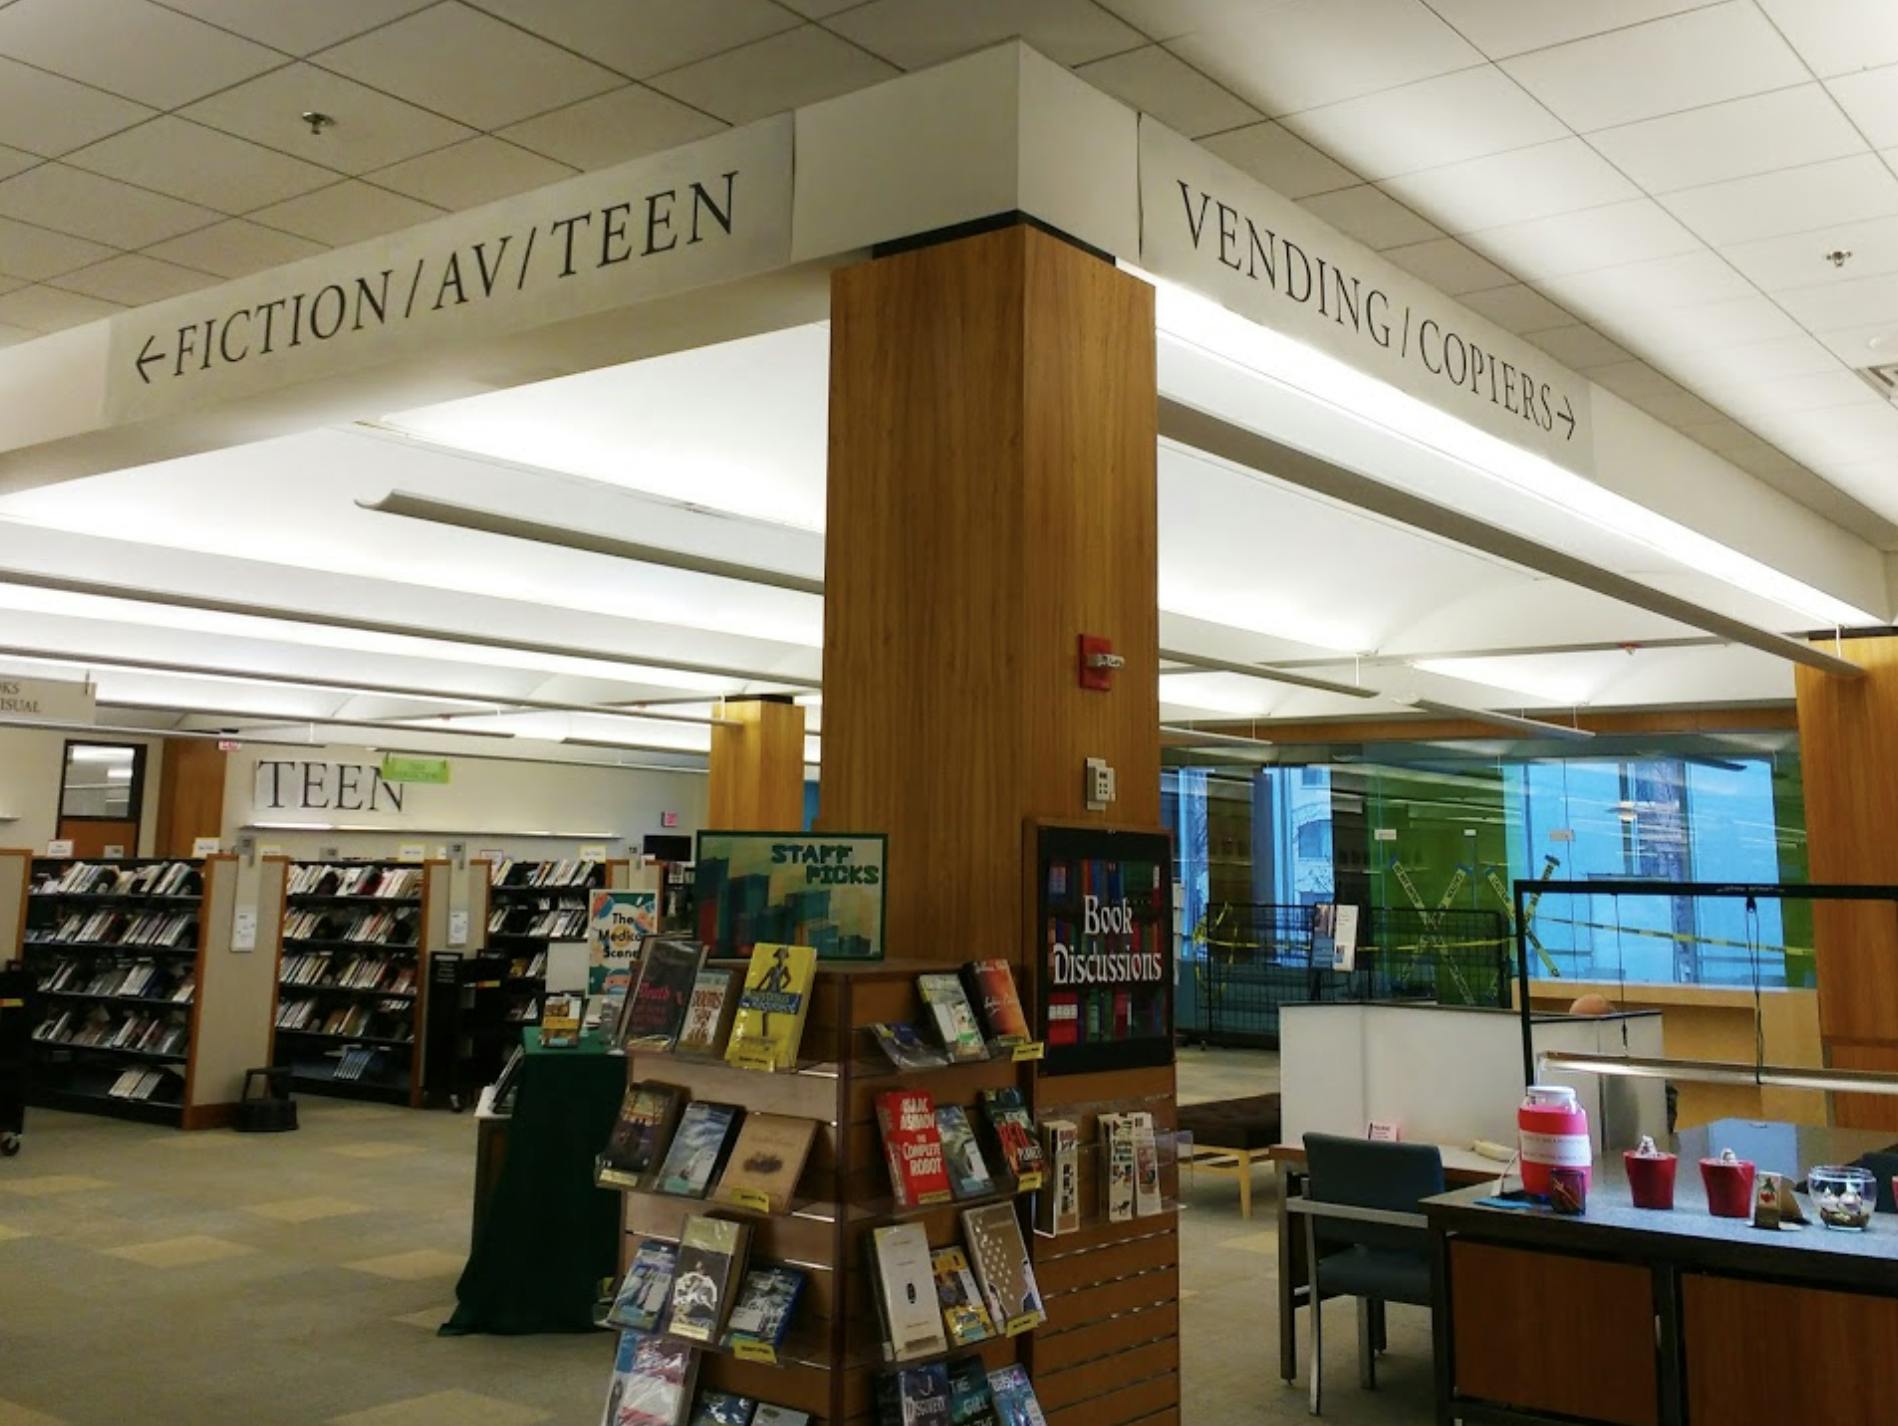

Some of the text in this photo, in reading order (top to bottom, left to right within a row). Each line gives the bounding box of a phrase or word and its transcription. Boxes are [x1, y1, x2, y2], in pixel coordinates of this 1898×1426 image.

[0, 697, 41, 713] ISUAL
[258, 759, 405, 812] TEEN
[771, 844, 853, 864] STAFF
[806, 865, 879, 884] PICKS
[612, 912, 634, 925] The
[1083, 894, 1134, 935] Book
[1053, 942, 1162, 984] Discussions
[910, 1157, 942, 1177] ROBOT
